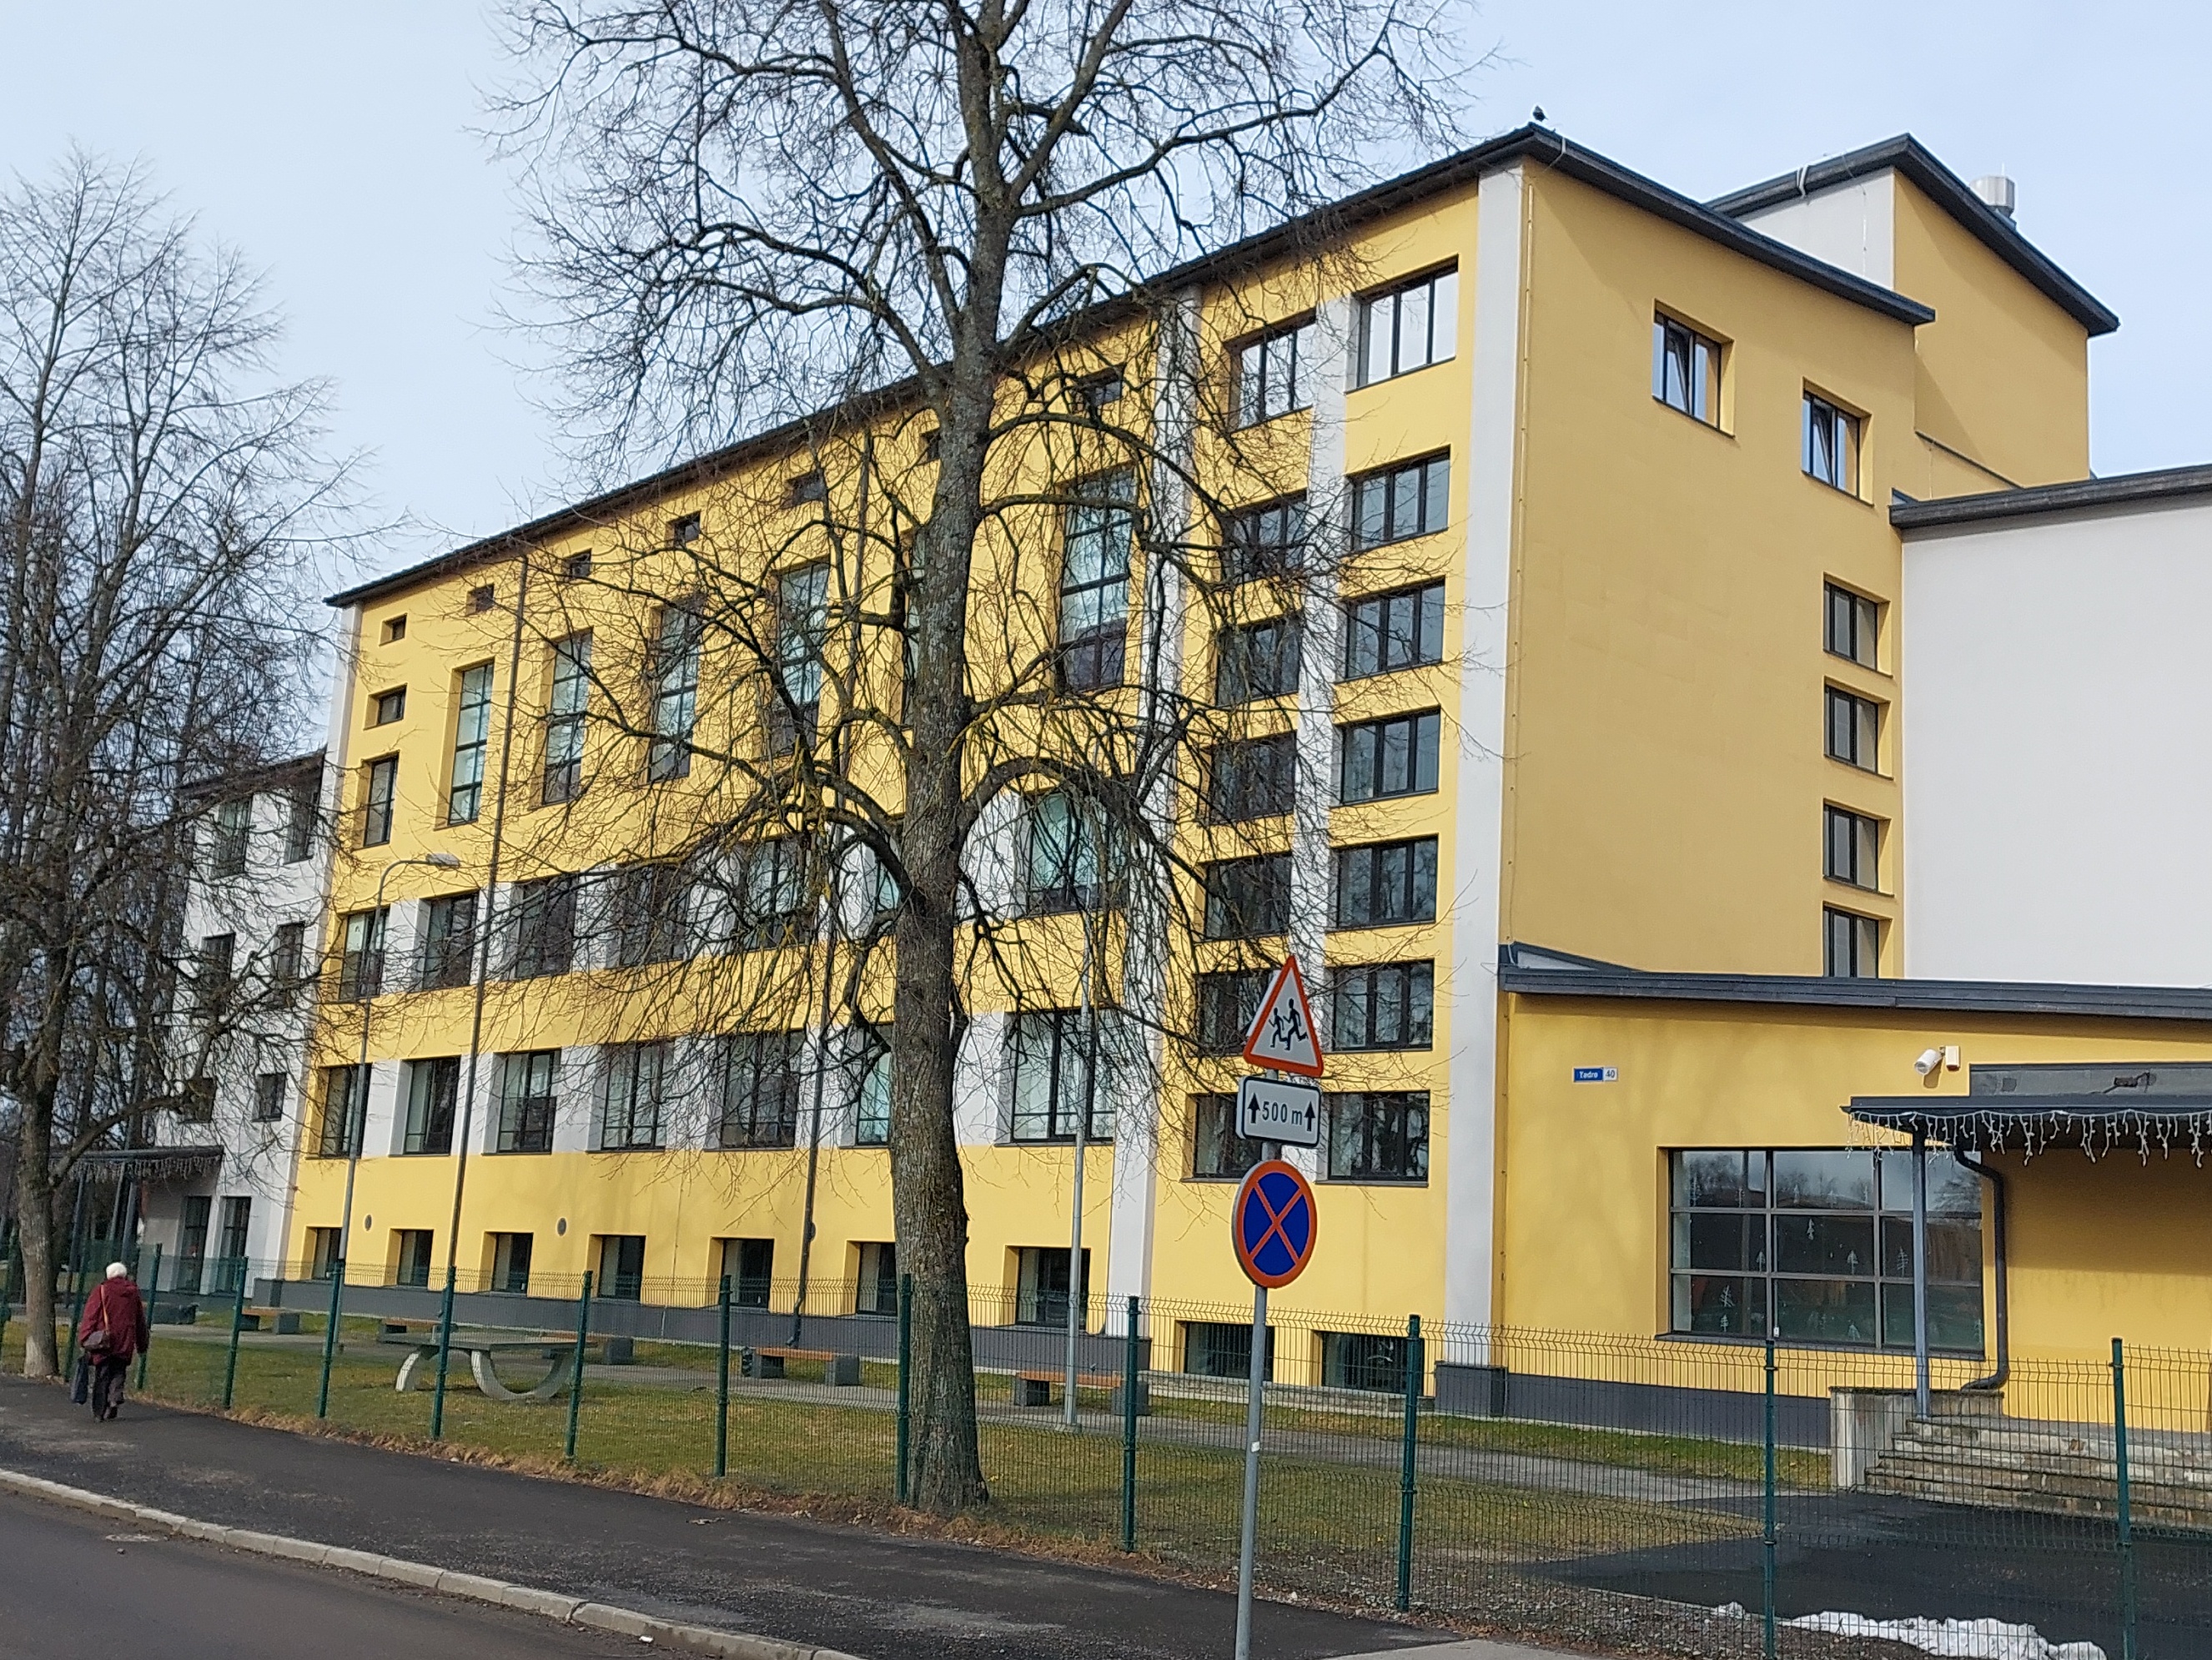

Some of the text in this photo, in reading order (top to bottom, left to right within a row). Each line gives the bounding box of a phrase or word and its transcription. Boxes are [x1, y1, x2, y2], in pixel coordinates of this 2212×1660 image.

[1605, 1069, 1616, 1079] 40
[1262, 1101, 1302, 1126] 500 m
